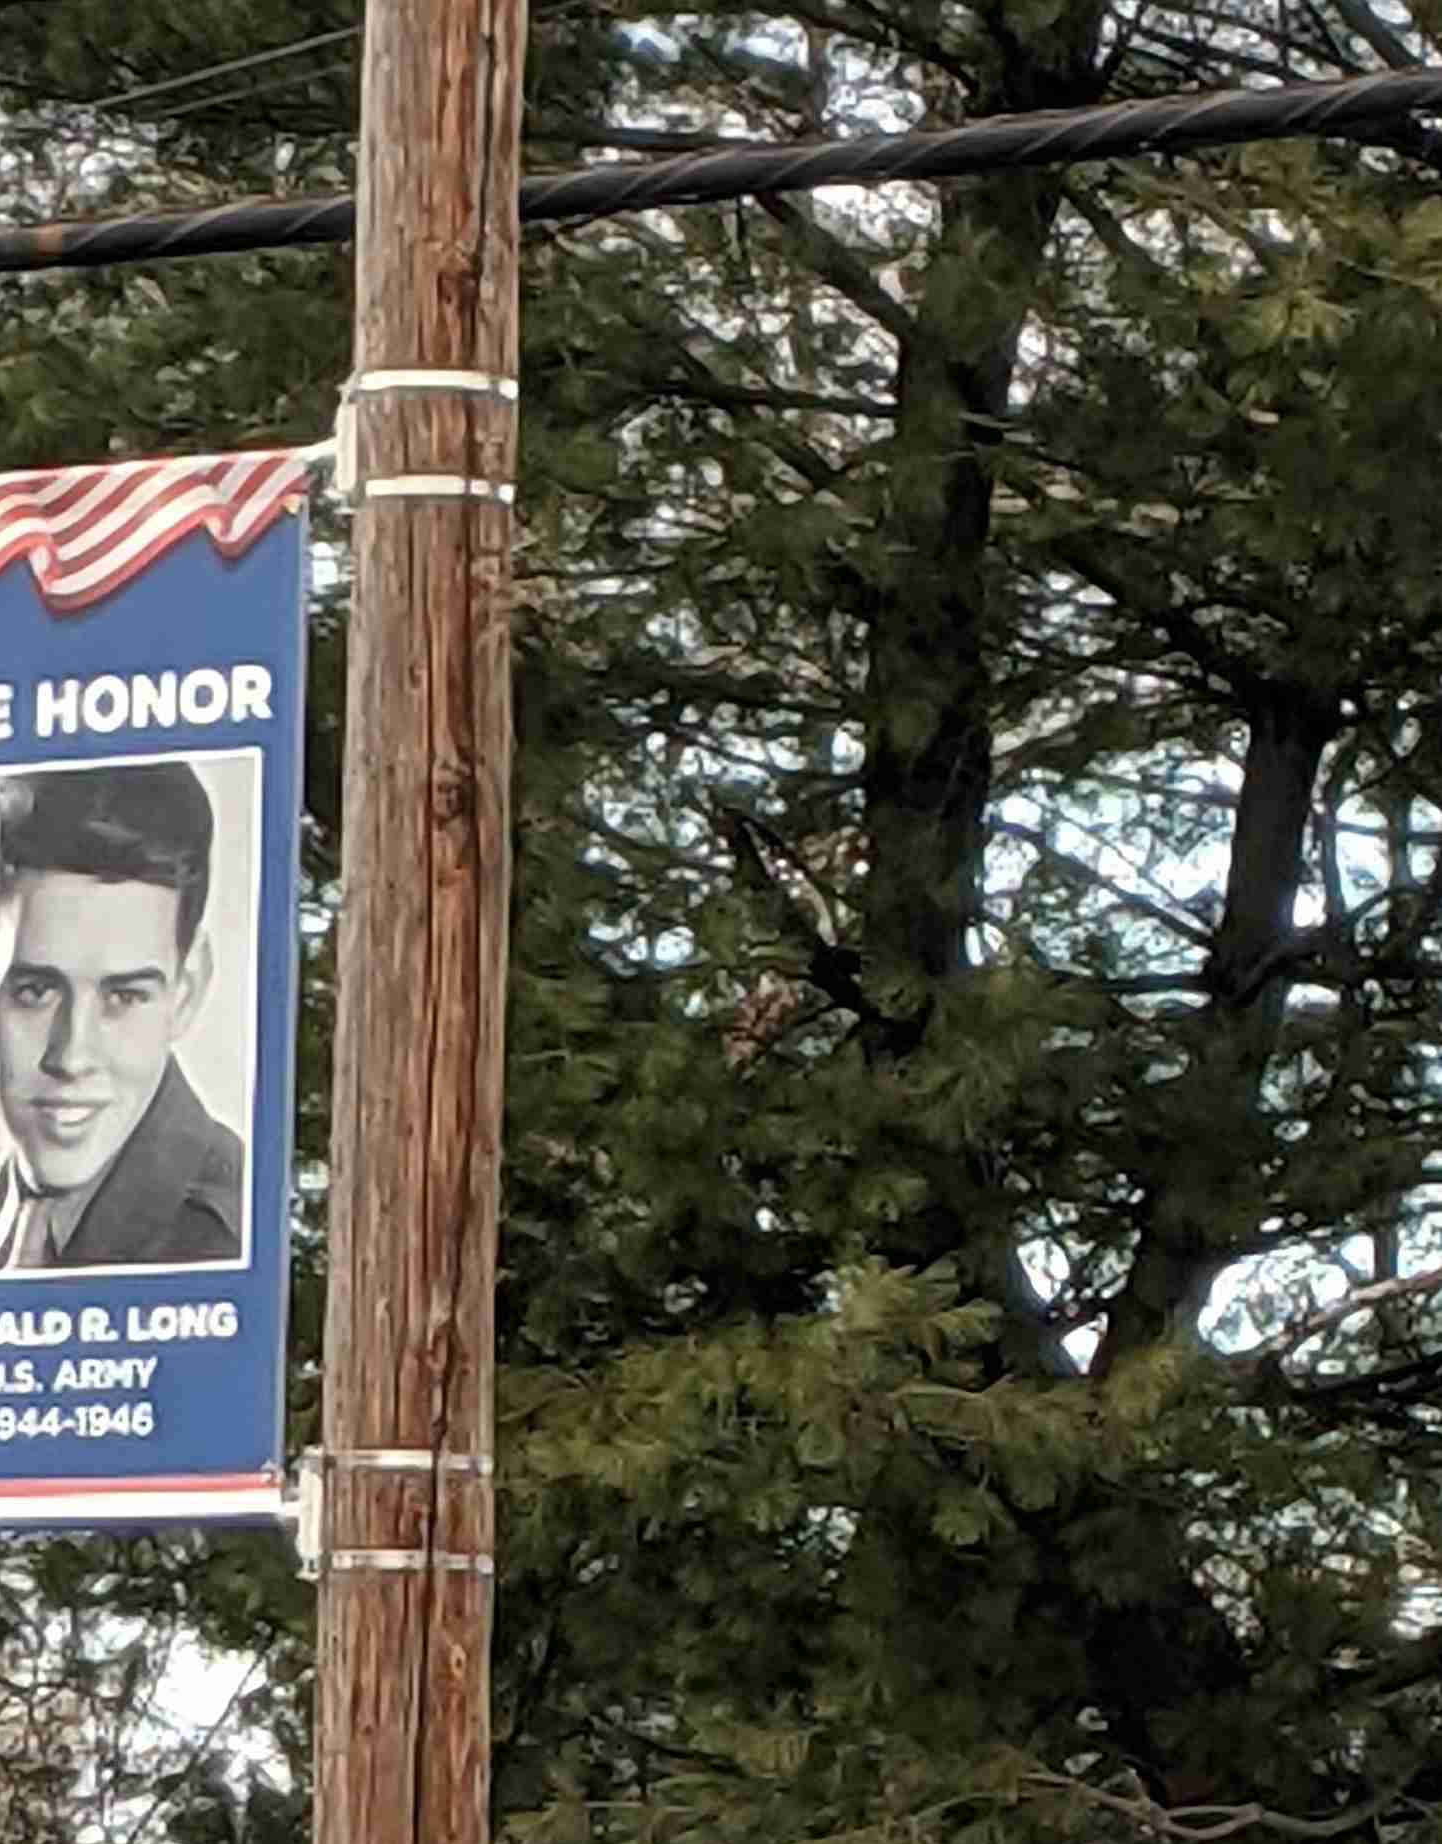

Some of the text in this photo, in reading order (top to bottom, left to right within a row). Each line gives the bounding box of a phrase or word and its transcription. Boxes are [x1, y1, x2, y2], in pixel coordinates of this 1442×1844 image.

[35, 664, 273, 737] HONOR
[79, 1306, 119, 1342] R.
[126, 1302, 239, 1342] LONG
[53, 1356, 158, 1391] ARMY
